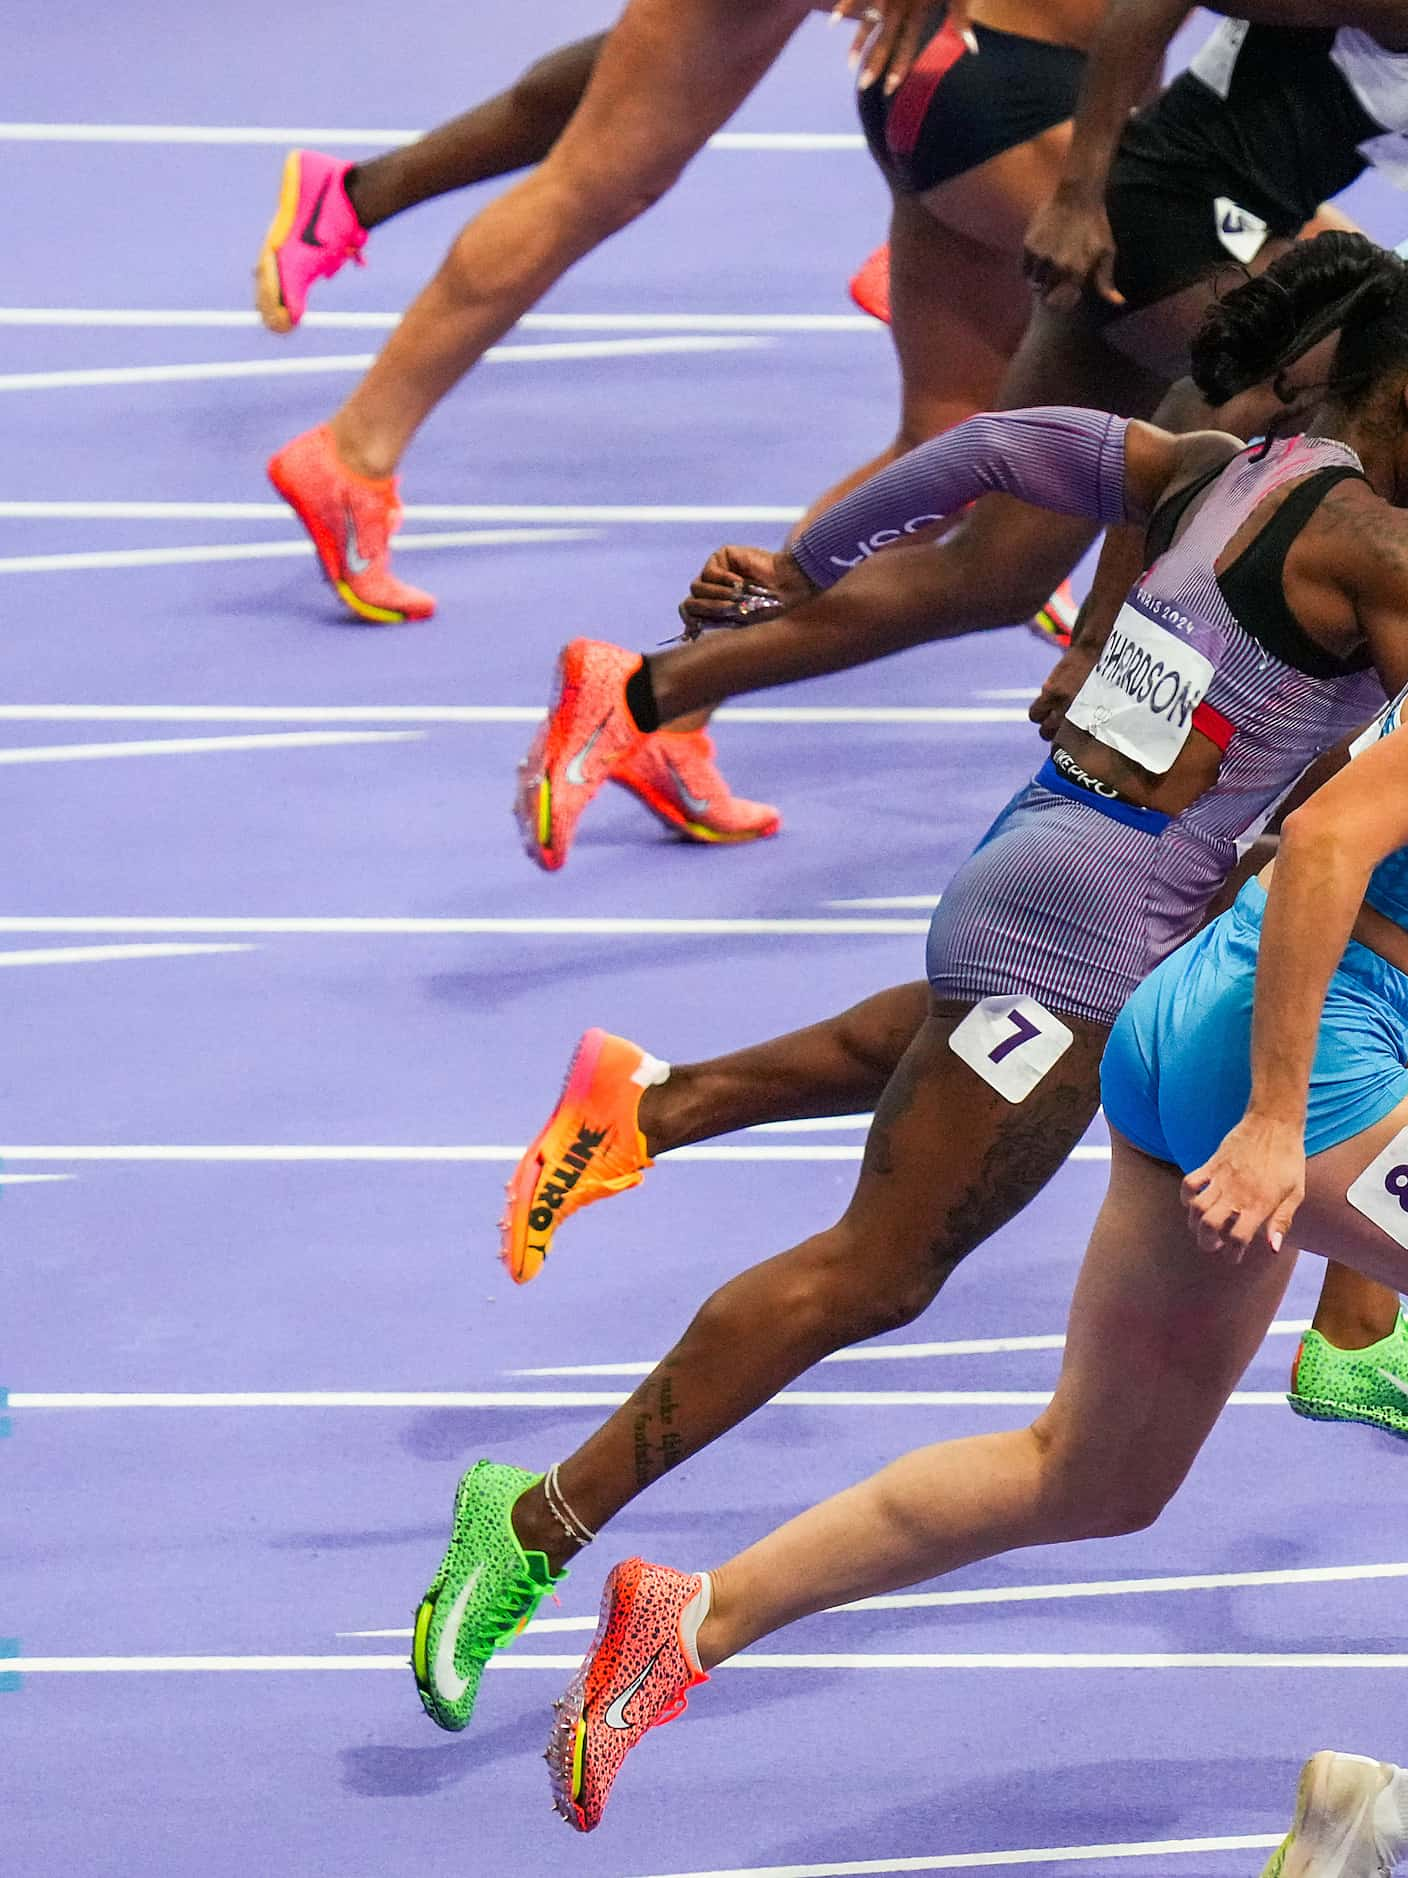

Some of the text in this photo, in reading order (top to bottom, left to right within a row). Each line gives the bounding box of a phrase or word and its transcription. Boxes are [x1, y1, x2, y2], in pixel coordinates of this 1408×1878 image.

[1136, 588, 1195, 634] PARIS 2024
[987, 1008, 1042, 1064] 7
[529, 1119, 609, 1231] NITRO
